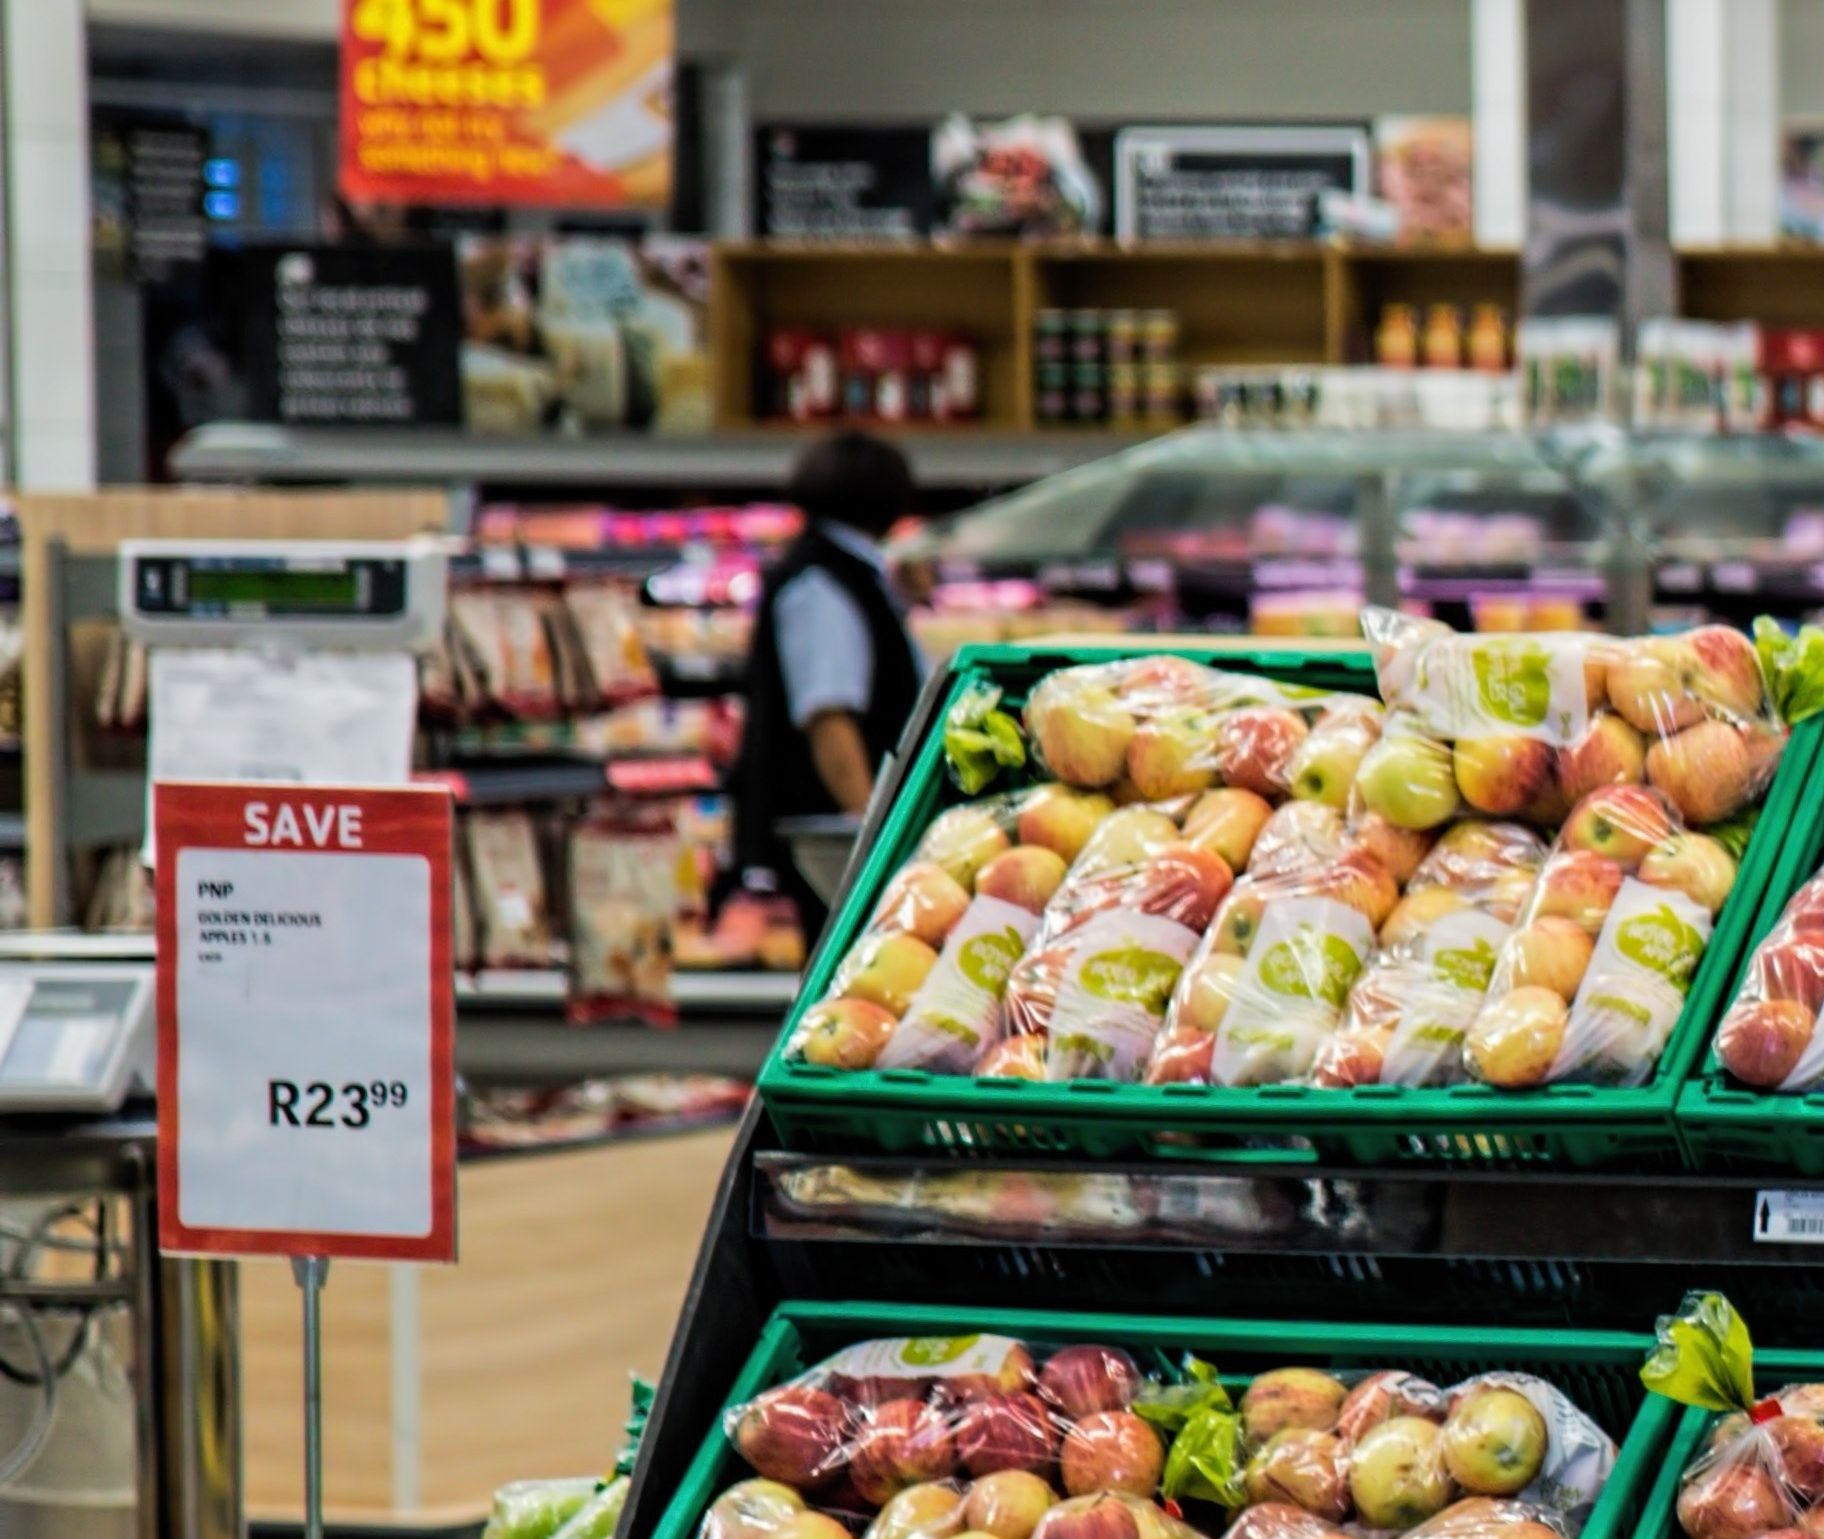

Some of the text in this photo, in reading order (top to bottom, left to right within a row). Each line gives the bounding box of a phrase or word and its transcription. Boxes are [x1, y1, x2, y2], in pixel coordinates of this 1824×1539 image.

[352, 0, 543, 60] 450
[245, 801, 363, 849] SAVE
[198, 881, 234, 900] PNP
[198, 912, 322, 928] GOLDEN DELICIOUS
[199, 930, 248, 945] APPLES
